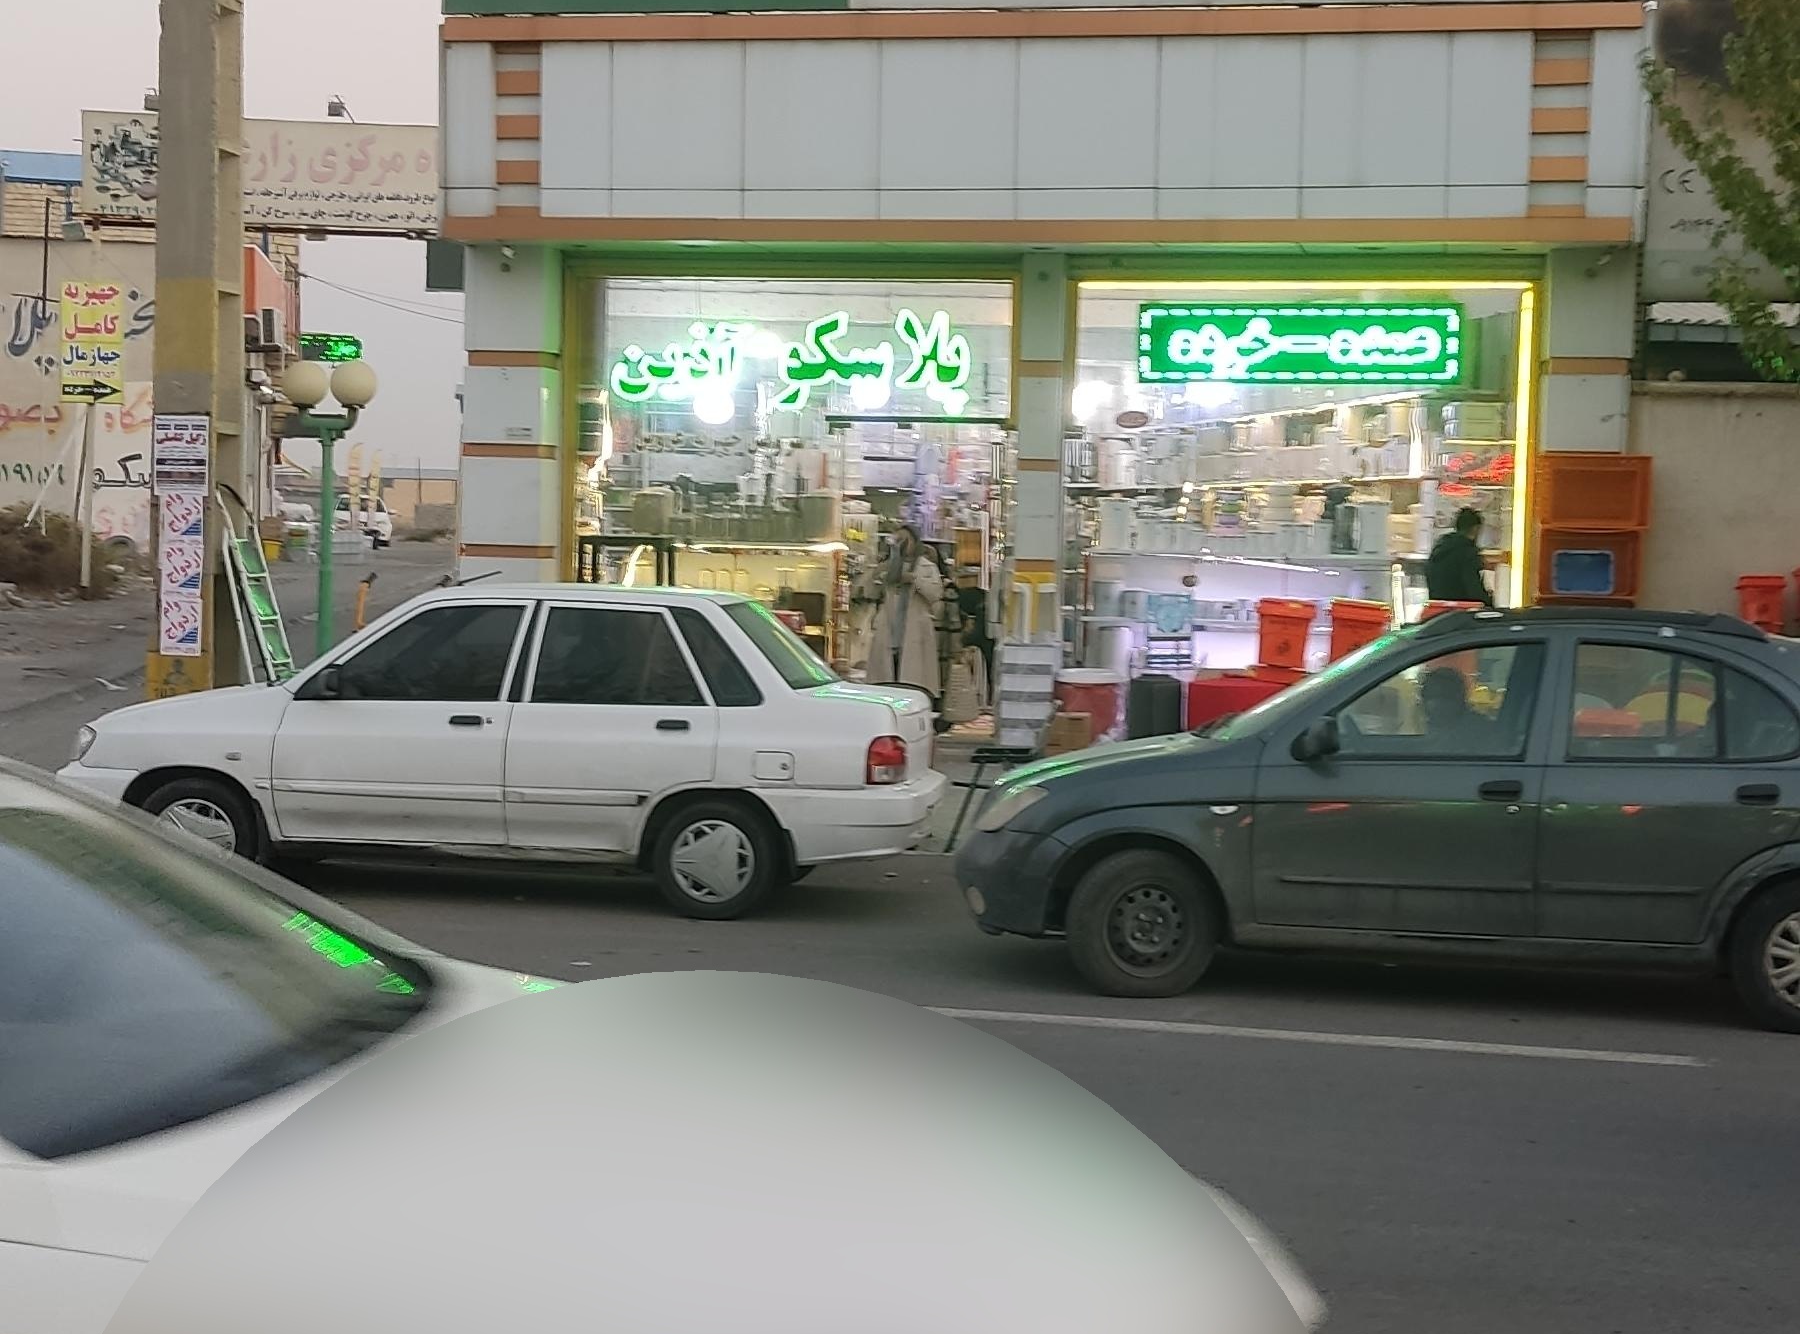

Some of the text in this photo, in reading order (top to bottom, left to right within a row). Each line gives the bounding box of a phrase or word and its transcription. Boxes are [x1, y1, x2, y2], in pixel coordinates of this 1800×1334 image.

[64, 313, 120, 340] کامل
[611, 309, 971, 414] پلاسکو آذین
